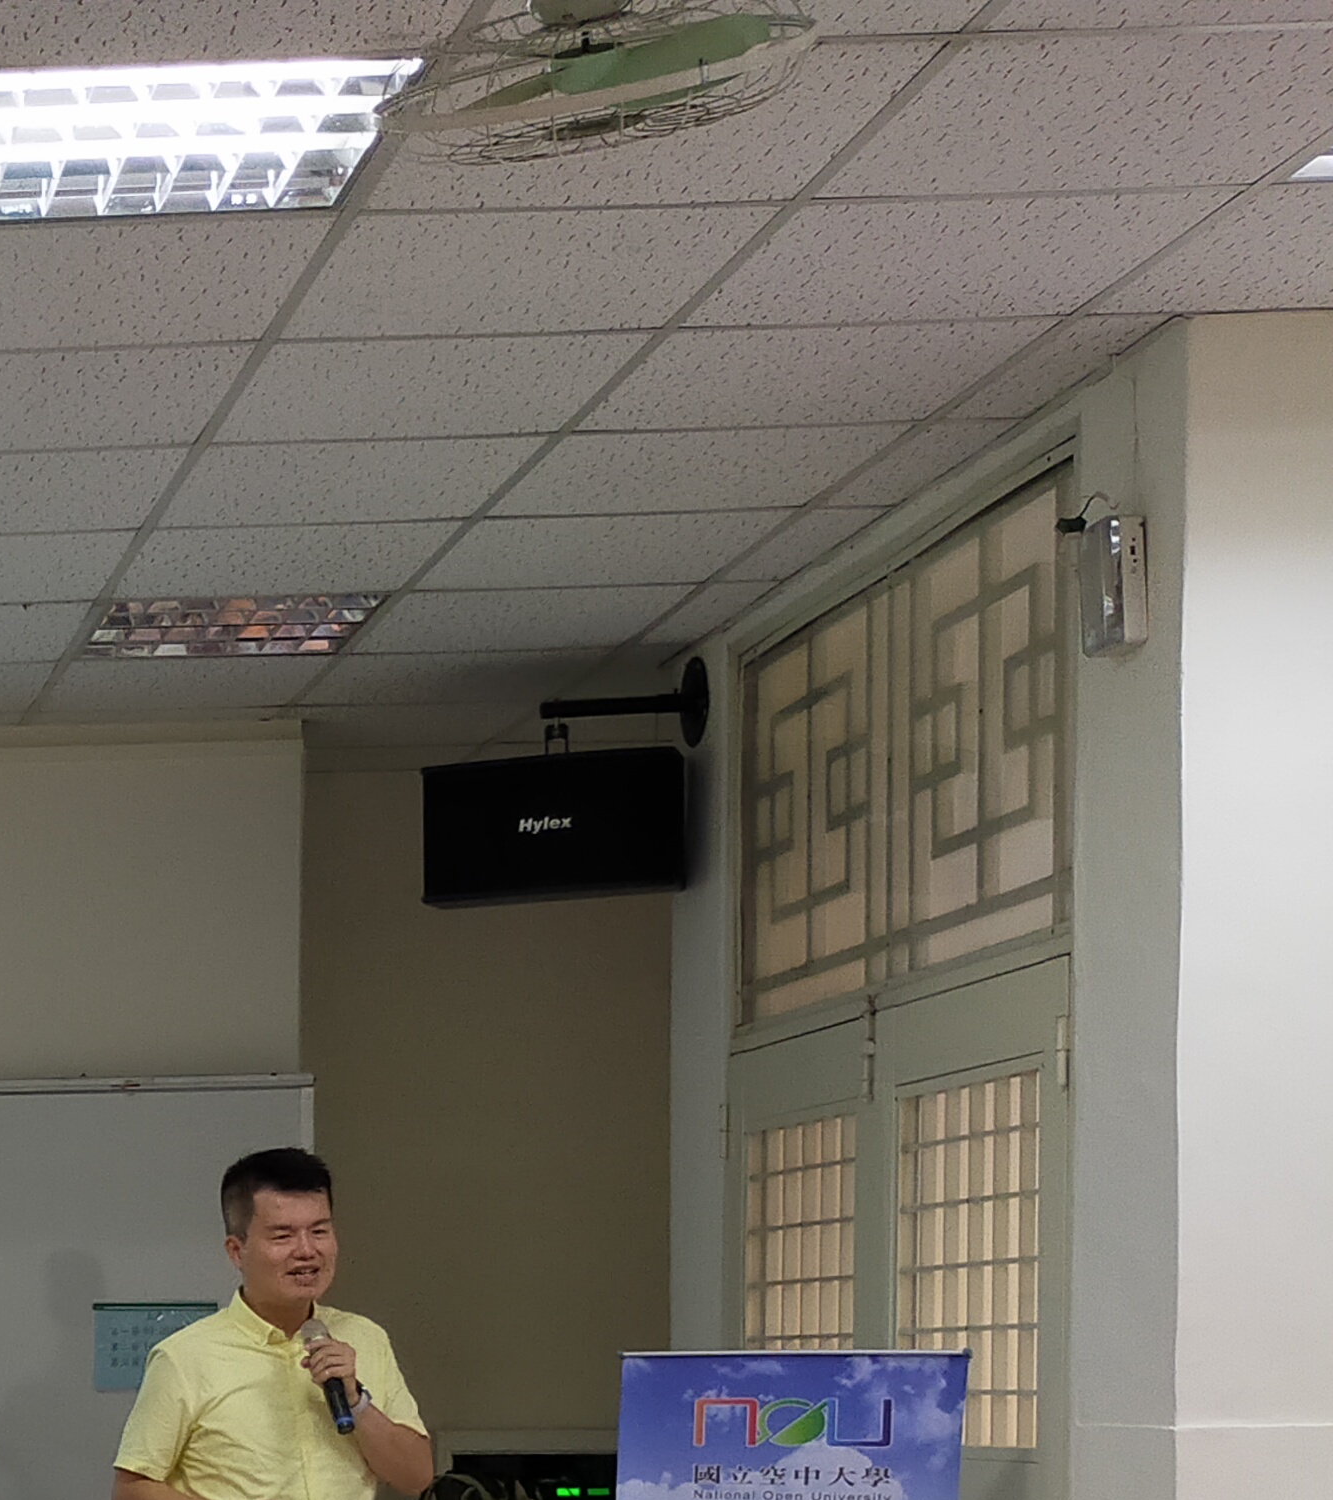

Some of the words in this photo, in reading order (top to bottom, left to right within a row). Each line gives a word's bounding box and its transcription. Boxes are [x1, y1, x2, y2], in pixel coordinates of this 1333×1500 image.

[518, 816, 572, 834] Hylex
[694, 1464, 892, 1488] 國立空中大學
[693, 1489, 755, 1500] National
